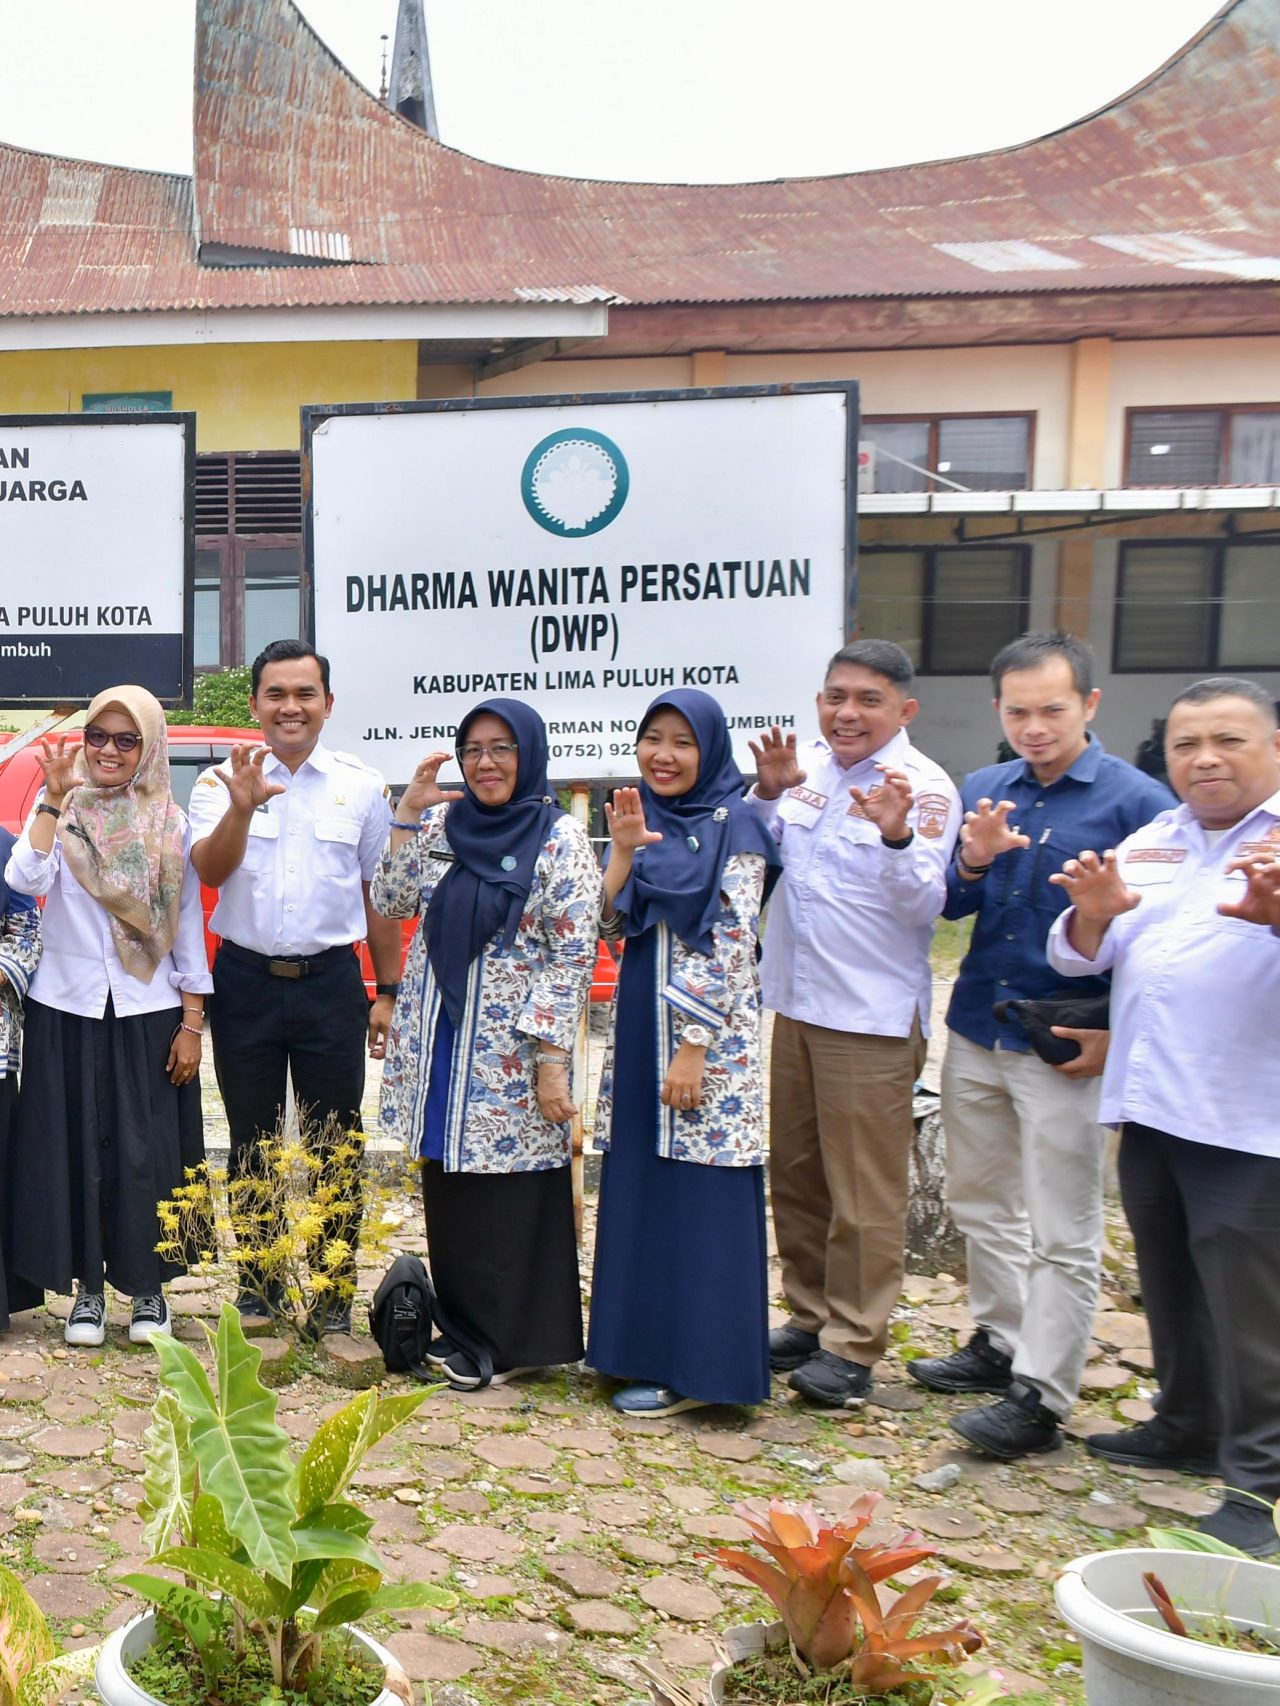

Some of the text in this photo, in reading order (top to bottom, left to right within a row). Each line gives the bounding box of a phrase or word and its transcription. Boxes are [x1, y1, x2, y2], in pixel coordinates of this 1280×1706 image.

[346, 558, 811, 613] DHARMA WANITA PERSATUAN
[18, 606, 89, 627] PULUH
[97, 606, 152, 626] KOTA
[530, 612, 619, 664] (DWP)
[413, 665, 739, 695] KABUPATEN LIMA PULUH KOTA
[362, 727, 404, 741] JLN.
[409, 725, 458, 740] JEND
[724, 714, 795, 730] UMBUH
